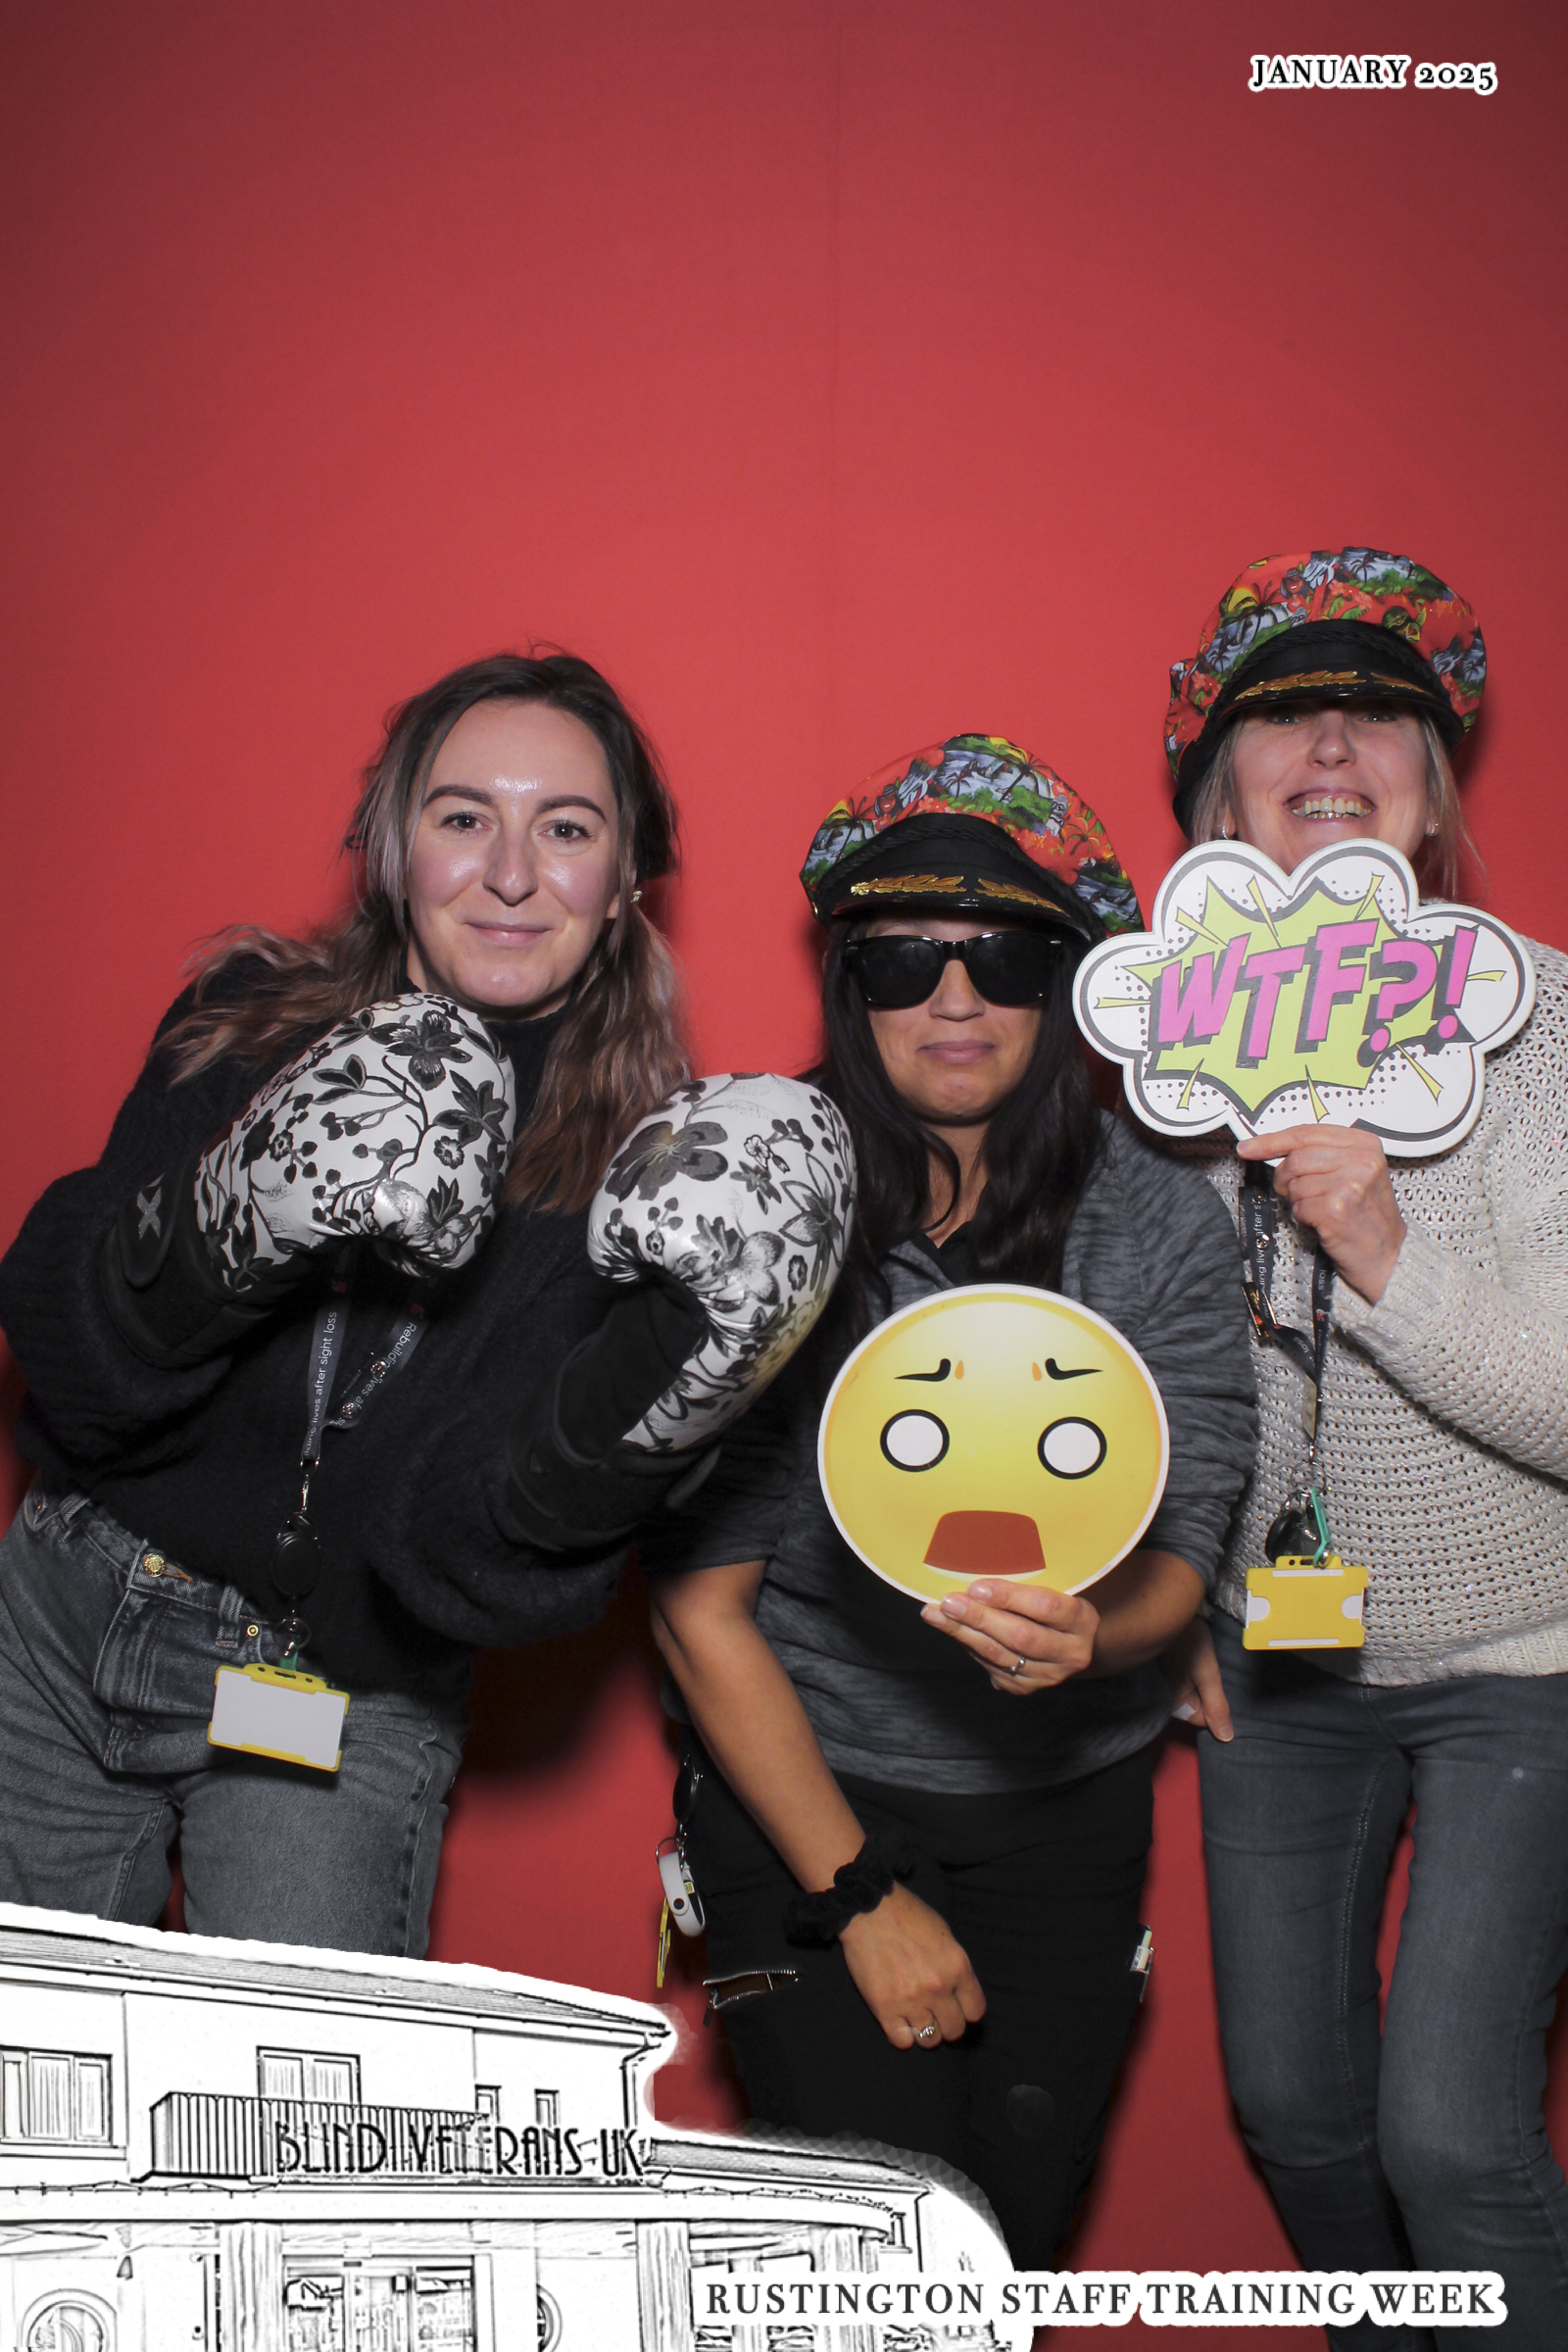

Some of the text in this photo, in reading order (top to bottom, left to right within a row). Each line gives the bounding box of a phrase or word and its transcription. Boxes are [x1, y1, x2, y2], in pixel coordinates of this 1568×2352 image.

[1154, 918, 1478, 1063] WTF?!
[323, 1311, 337, 1334] loss
[318, 1337, 333, 1366] sight
[383, 1322, 417, 1371] Rebuildin
[315, 1367, 326, 1396] after
[312, 1396, 321, 1424] lives
